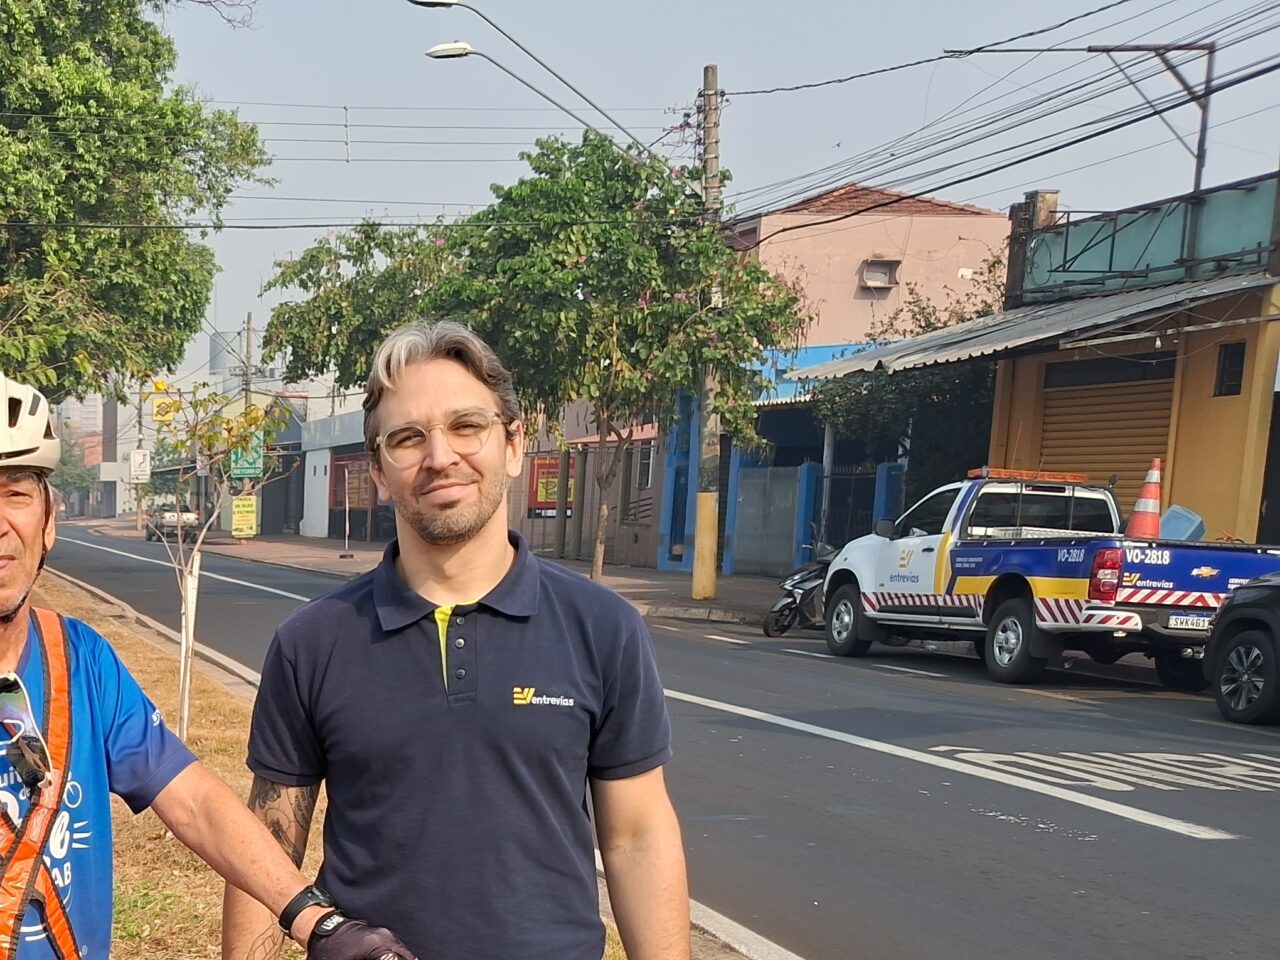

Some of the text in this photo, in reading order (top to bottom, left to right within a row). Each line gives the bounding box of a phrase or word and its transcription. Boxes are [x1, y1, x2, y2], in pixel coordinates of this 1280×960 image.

[1057, 549, 1085, 562] VO-2818
[1125, 549, 1170, 564] VO-2818
[889, 571, 920, 583] entrevias
[531, 695, 574, 706] entrevias
